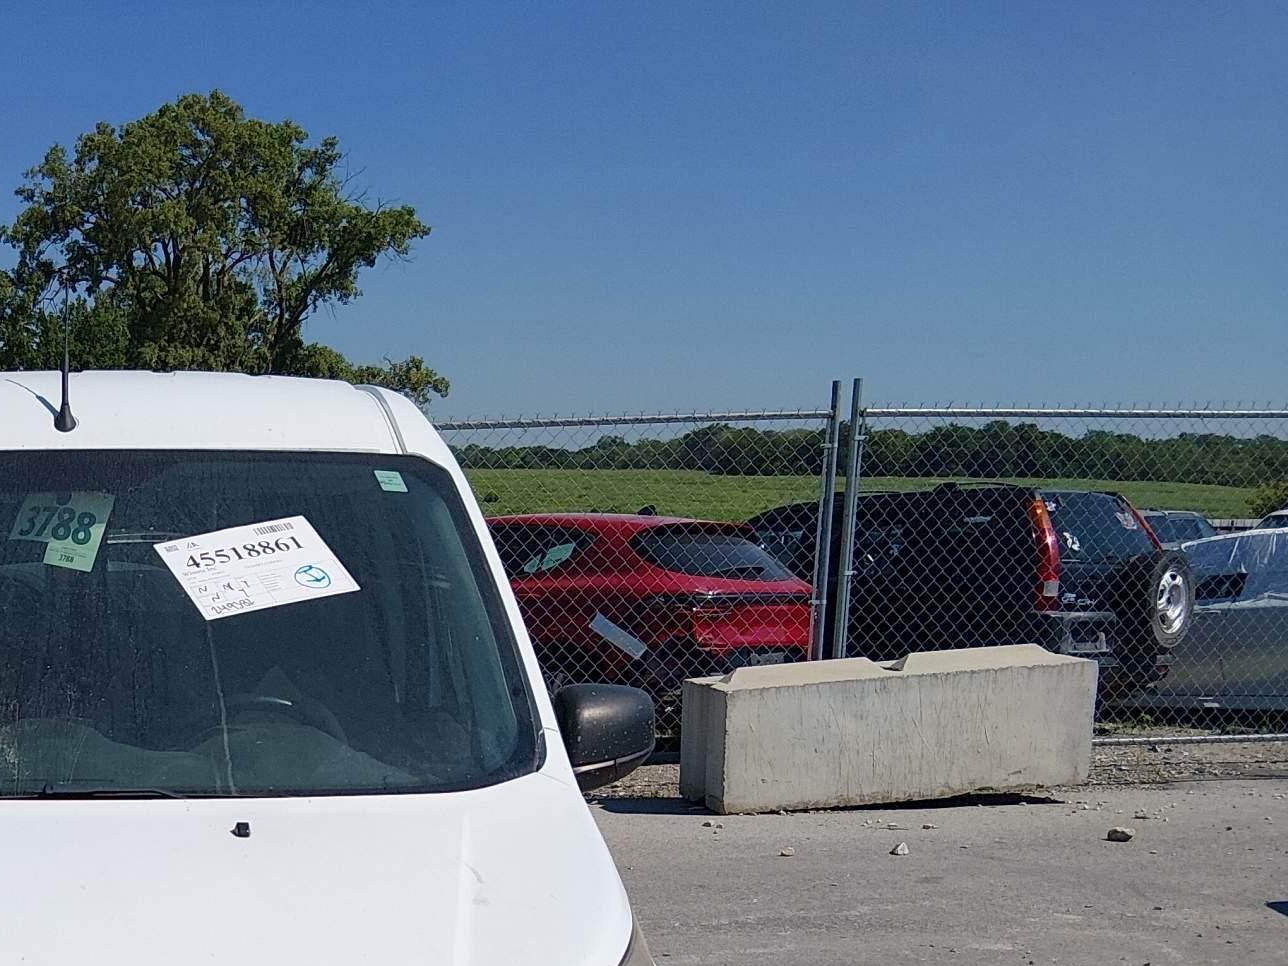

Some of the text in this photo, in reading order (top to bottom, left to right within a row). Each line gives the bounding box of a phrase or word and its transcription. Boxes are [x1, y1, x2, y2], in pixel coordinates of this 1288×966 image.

[18, 506, 97, 545] 3788
[58, 553, 75, 563] 3788
[186, 535, 304, 568] 45518861
